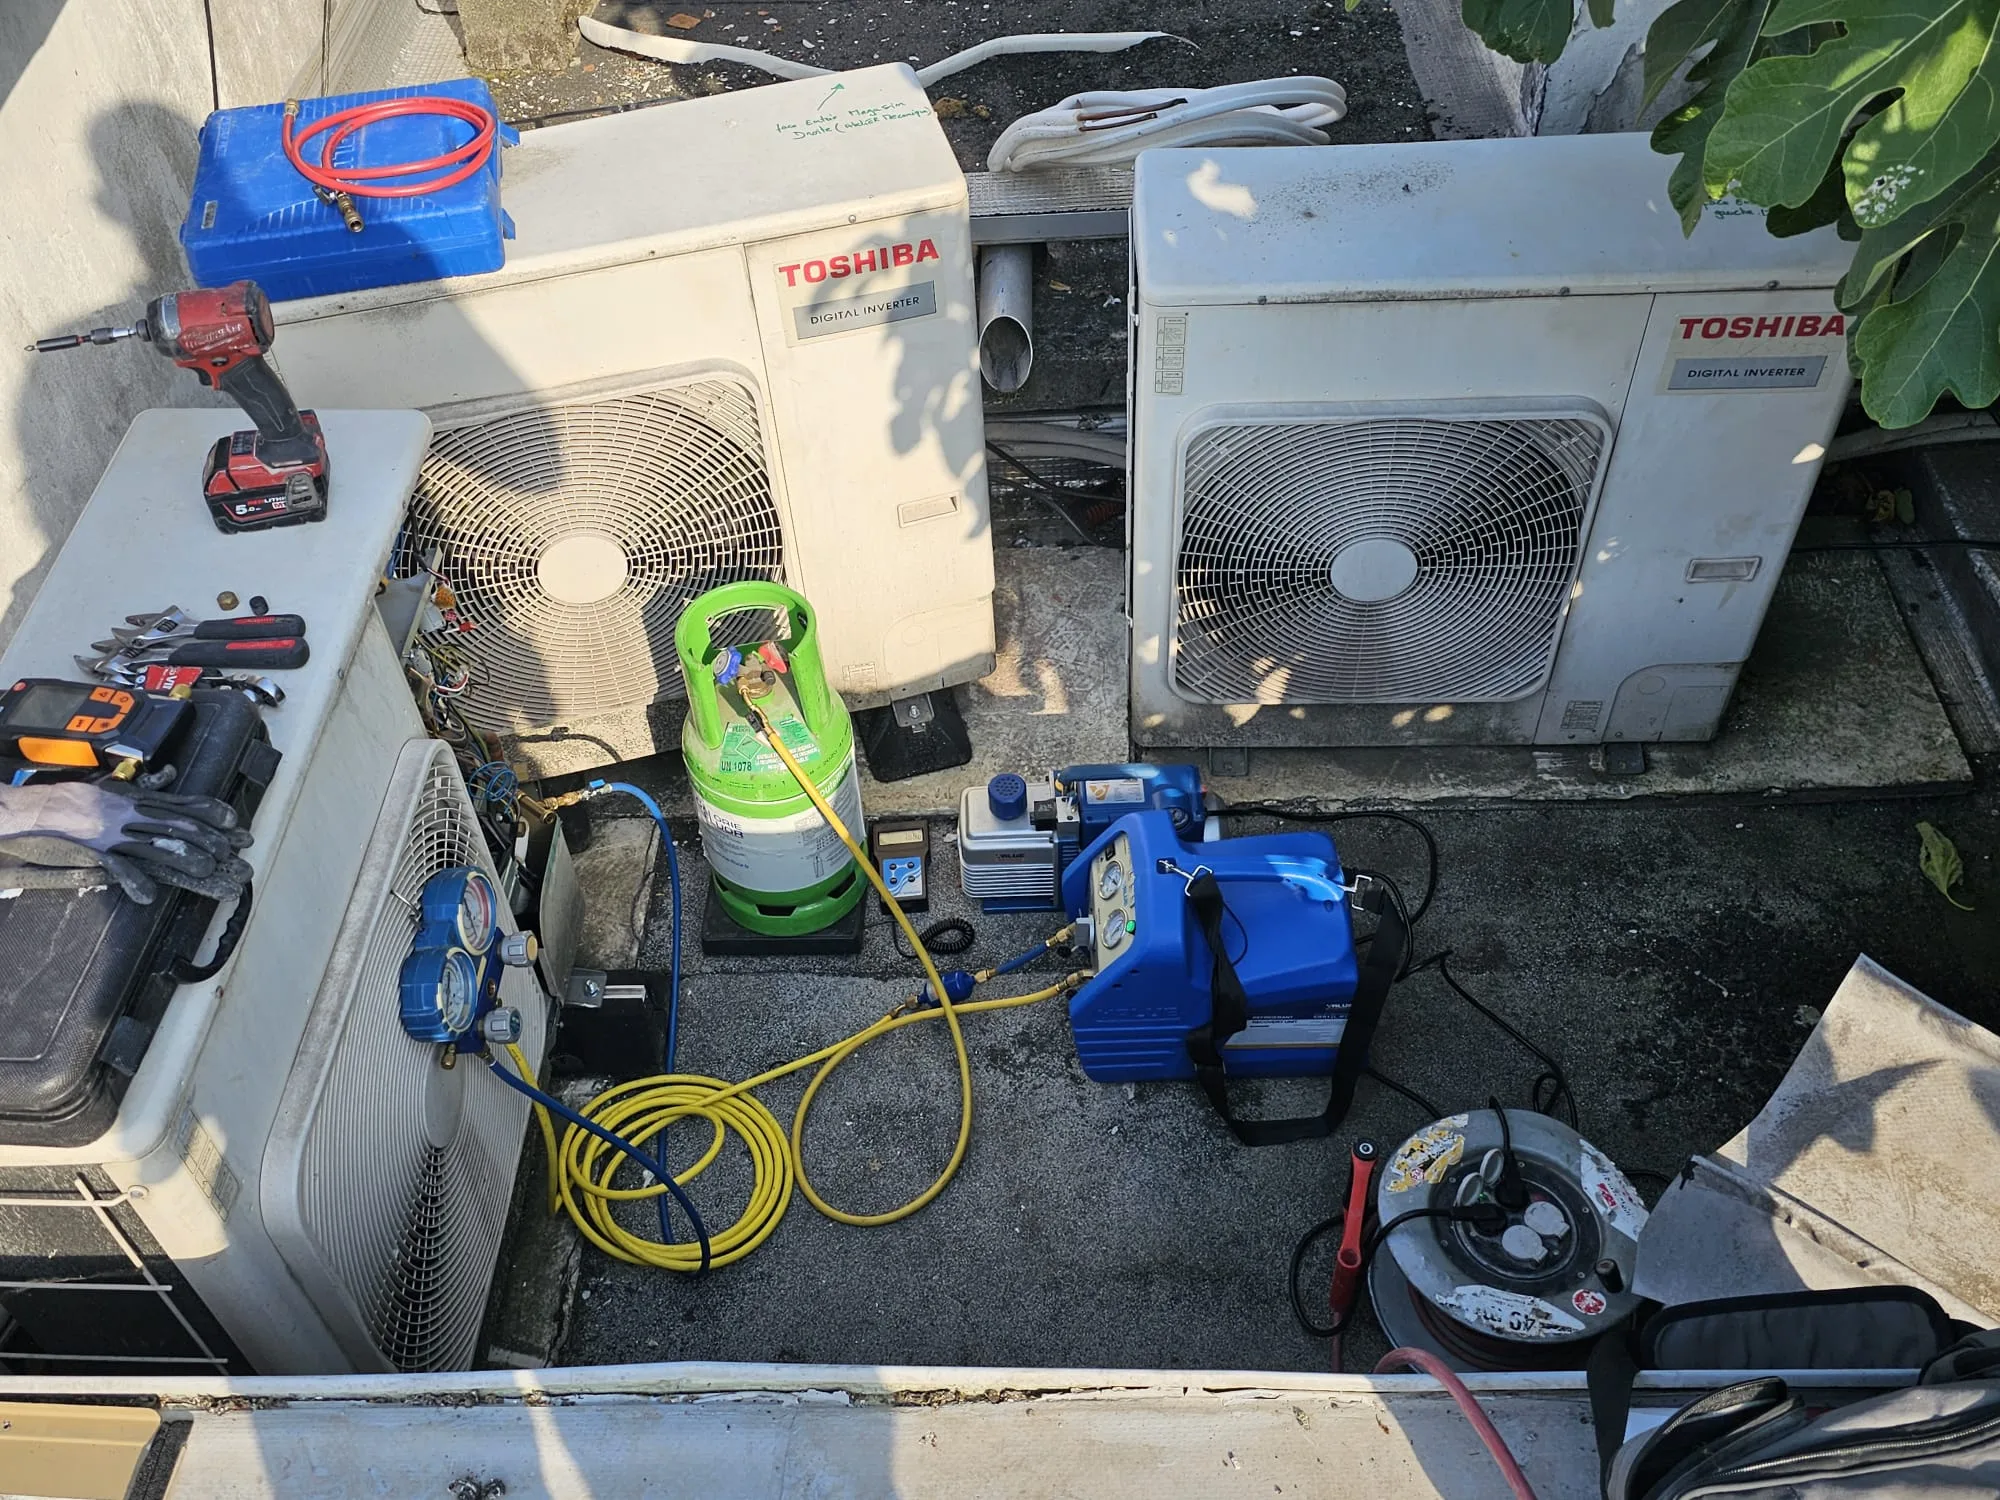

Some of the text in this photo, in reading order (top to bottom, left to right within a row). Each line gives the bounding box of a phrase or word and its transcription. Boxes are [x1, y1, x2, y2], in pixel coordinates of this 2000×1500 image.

[778, 238, 939, 287] TOSHIBA
[810, 296, 920, 325] DIGITAL INVERTER
[1680, 315, 1844, 340] TOSHIBA
[1687, 367, 1806, 378] DIGITAL INVERTER
